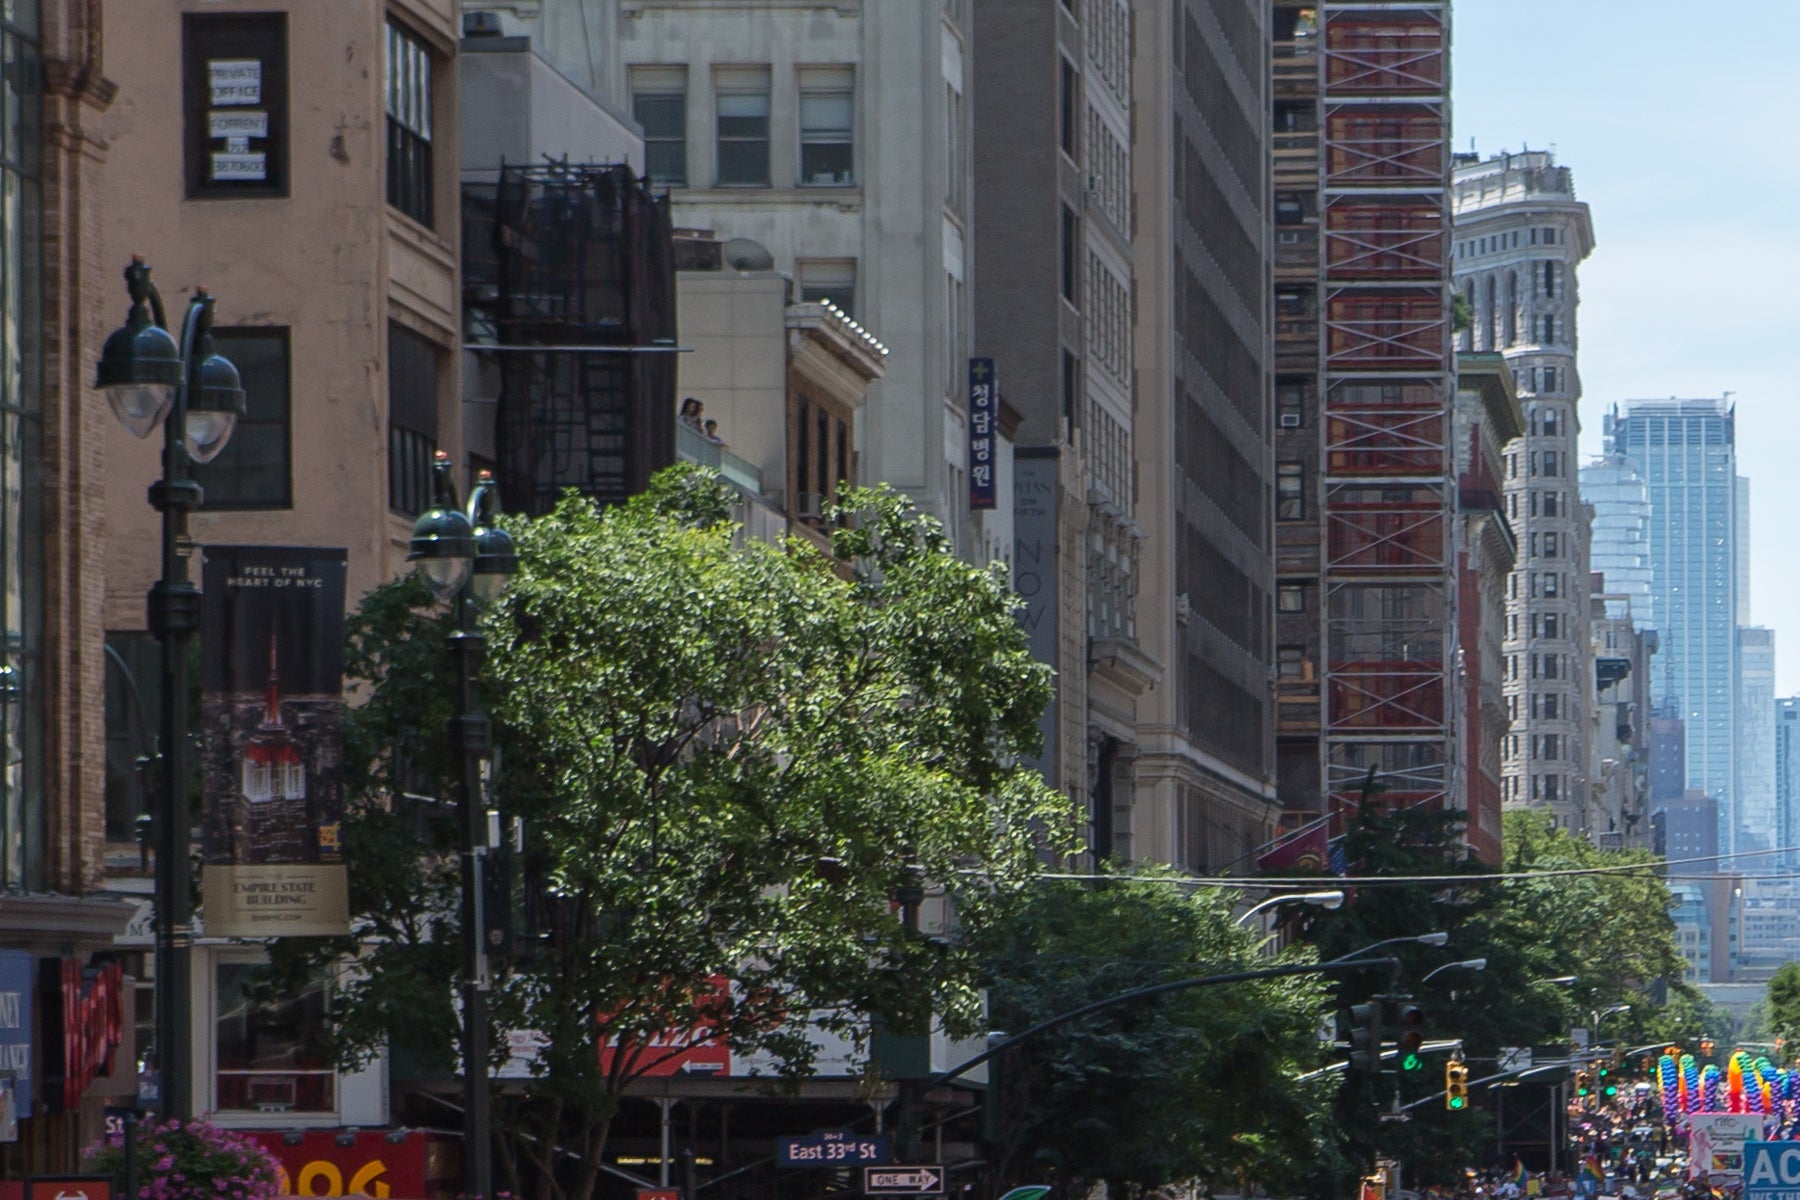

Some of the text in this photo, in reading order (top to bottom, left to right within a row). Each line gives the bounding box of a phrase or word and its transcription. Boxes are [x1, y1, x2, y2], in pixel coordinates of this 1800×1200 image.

[245, 567, 305, 577] FEEL THE
[228, 578, 322, 588] HEART OF NYC
[233, 883, 318, 893] EMPIRE STATE
[105, 1116, 125, 1134] St
[789, 1142, 877, 1160] East 33rd St
[279, 1160, 390, 1199] OG
[876, 1174, 931, 1186] ONE WAY
